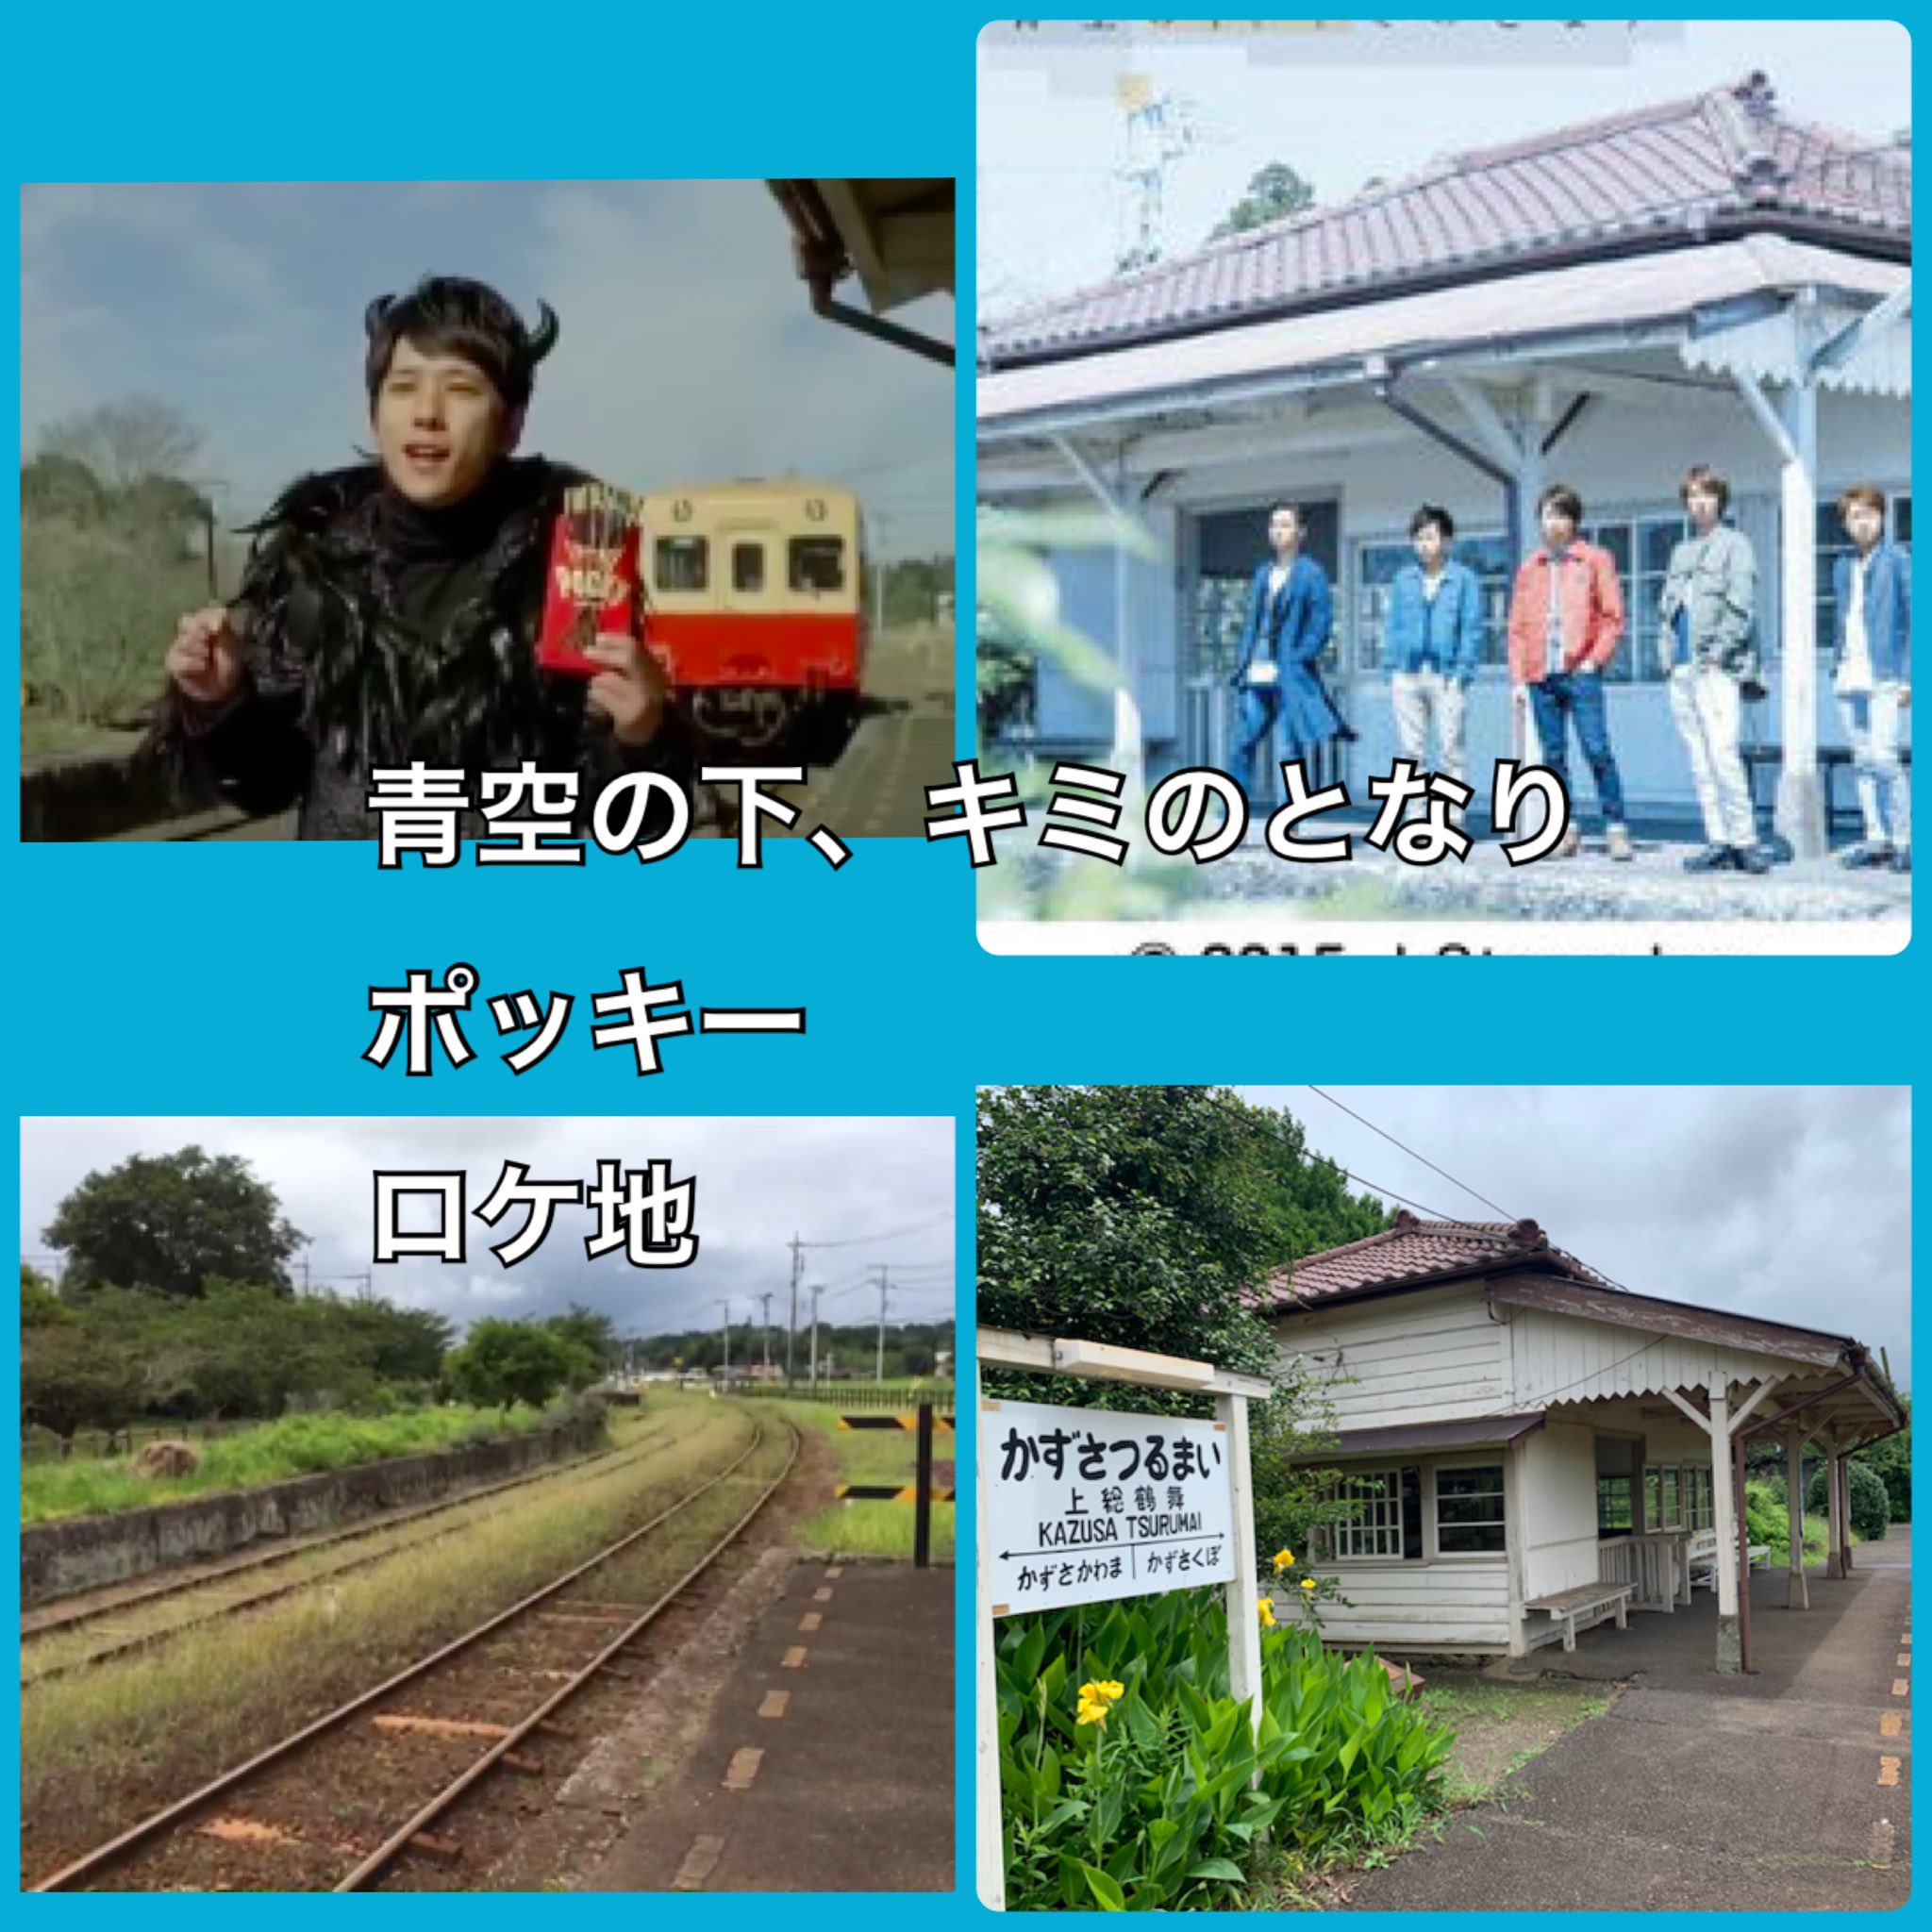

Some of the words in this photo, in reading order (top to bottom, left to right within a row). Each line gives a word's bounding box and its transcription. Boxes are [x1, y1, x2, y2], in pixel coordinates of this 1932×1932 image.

[1000, 1426, 1221, 1482] かずさつるまい
[1064, 1484, 1185, 1516] 上総鶴舞
[1039, 1516, 1118, 1548] KAZUSA
[1125, 1511, 1202, 1540] TSURUMAI
[1017, 1555, 1124, 1592] かずさかわま
[1146, 1543, 1223, 1574] かずさくぼ
